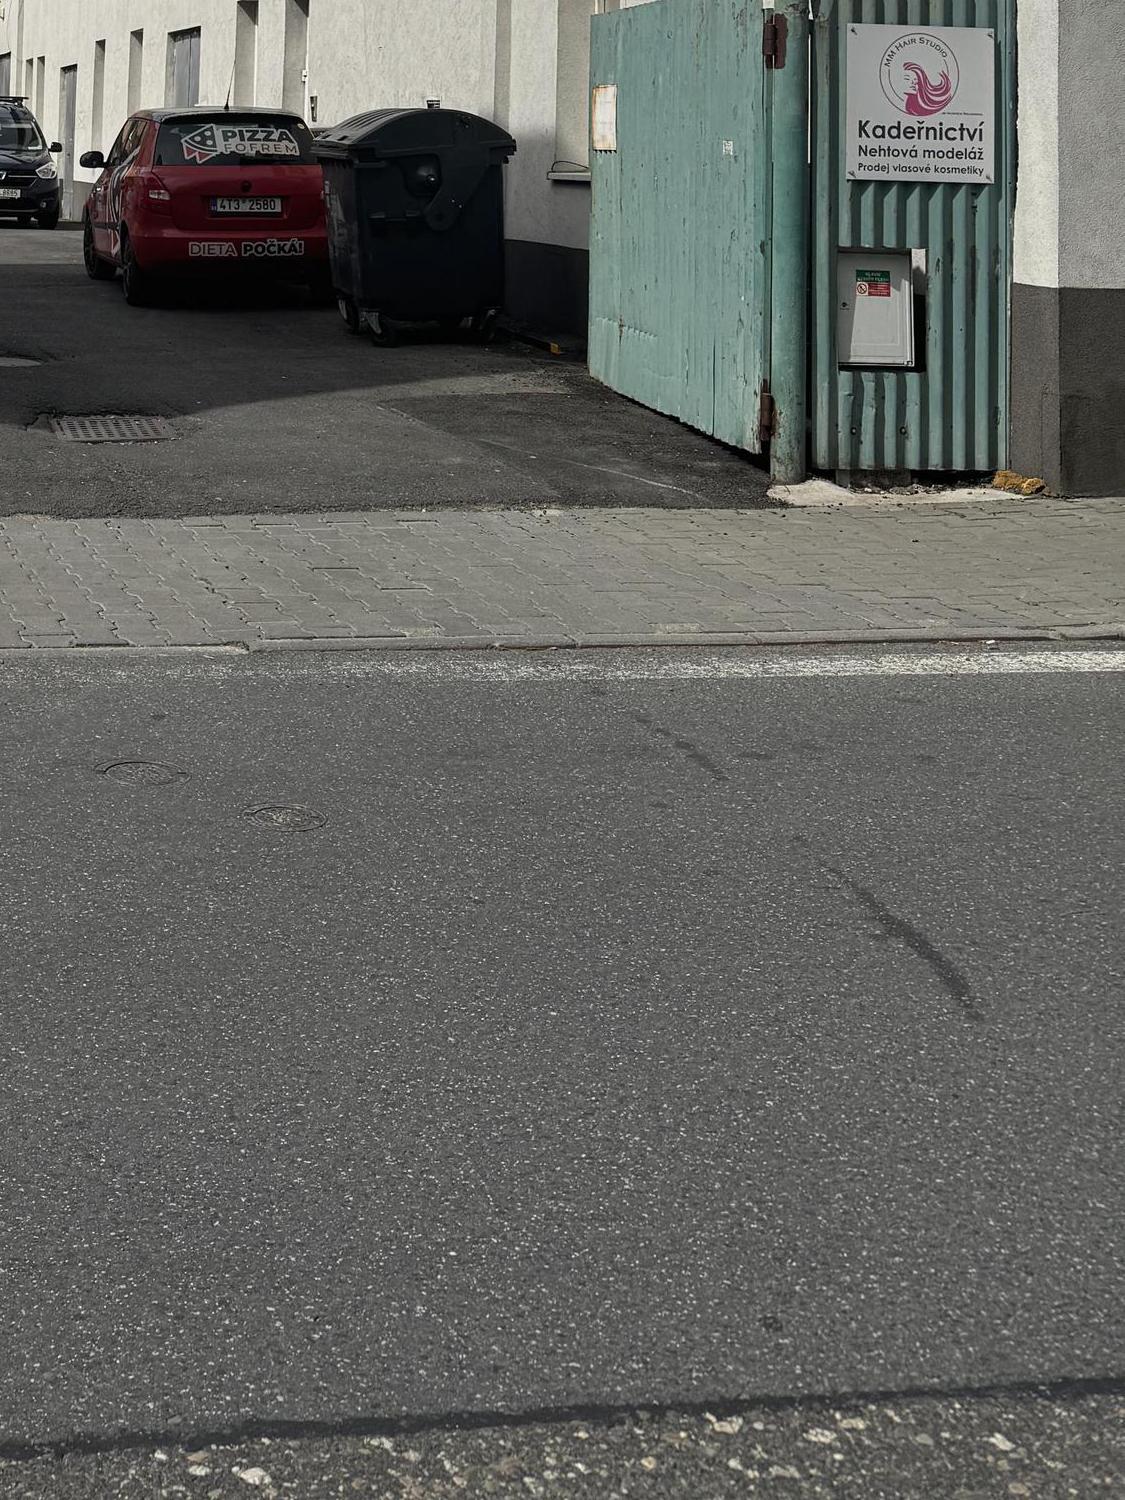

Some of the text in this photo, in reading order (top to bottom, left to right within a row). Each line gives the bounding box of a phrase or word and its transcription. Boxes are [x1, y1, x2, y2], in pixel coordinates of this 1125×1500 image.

[883, 50, 897, 67] MM
[220, 128, 296, 143] PIZZA
[858, 119, 985, 142] Kadeřnictví
[223, 143, 298, 153] FOFREM
[858, 144, 984, 161] Nehtová modeláž
[857, 162, 984, 177] Prodej vlasové kosmetiky
[219, 197, 276, 211] 4T3 2580
[189, 238, 305, 256] DIETA POČKÁ!
